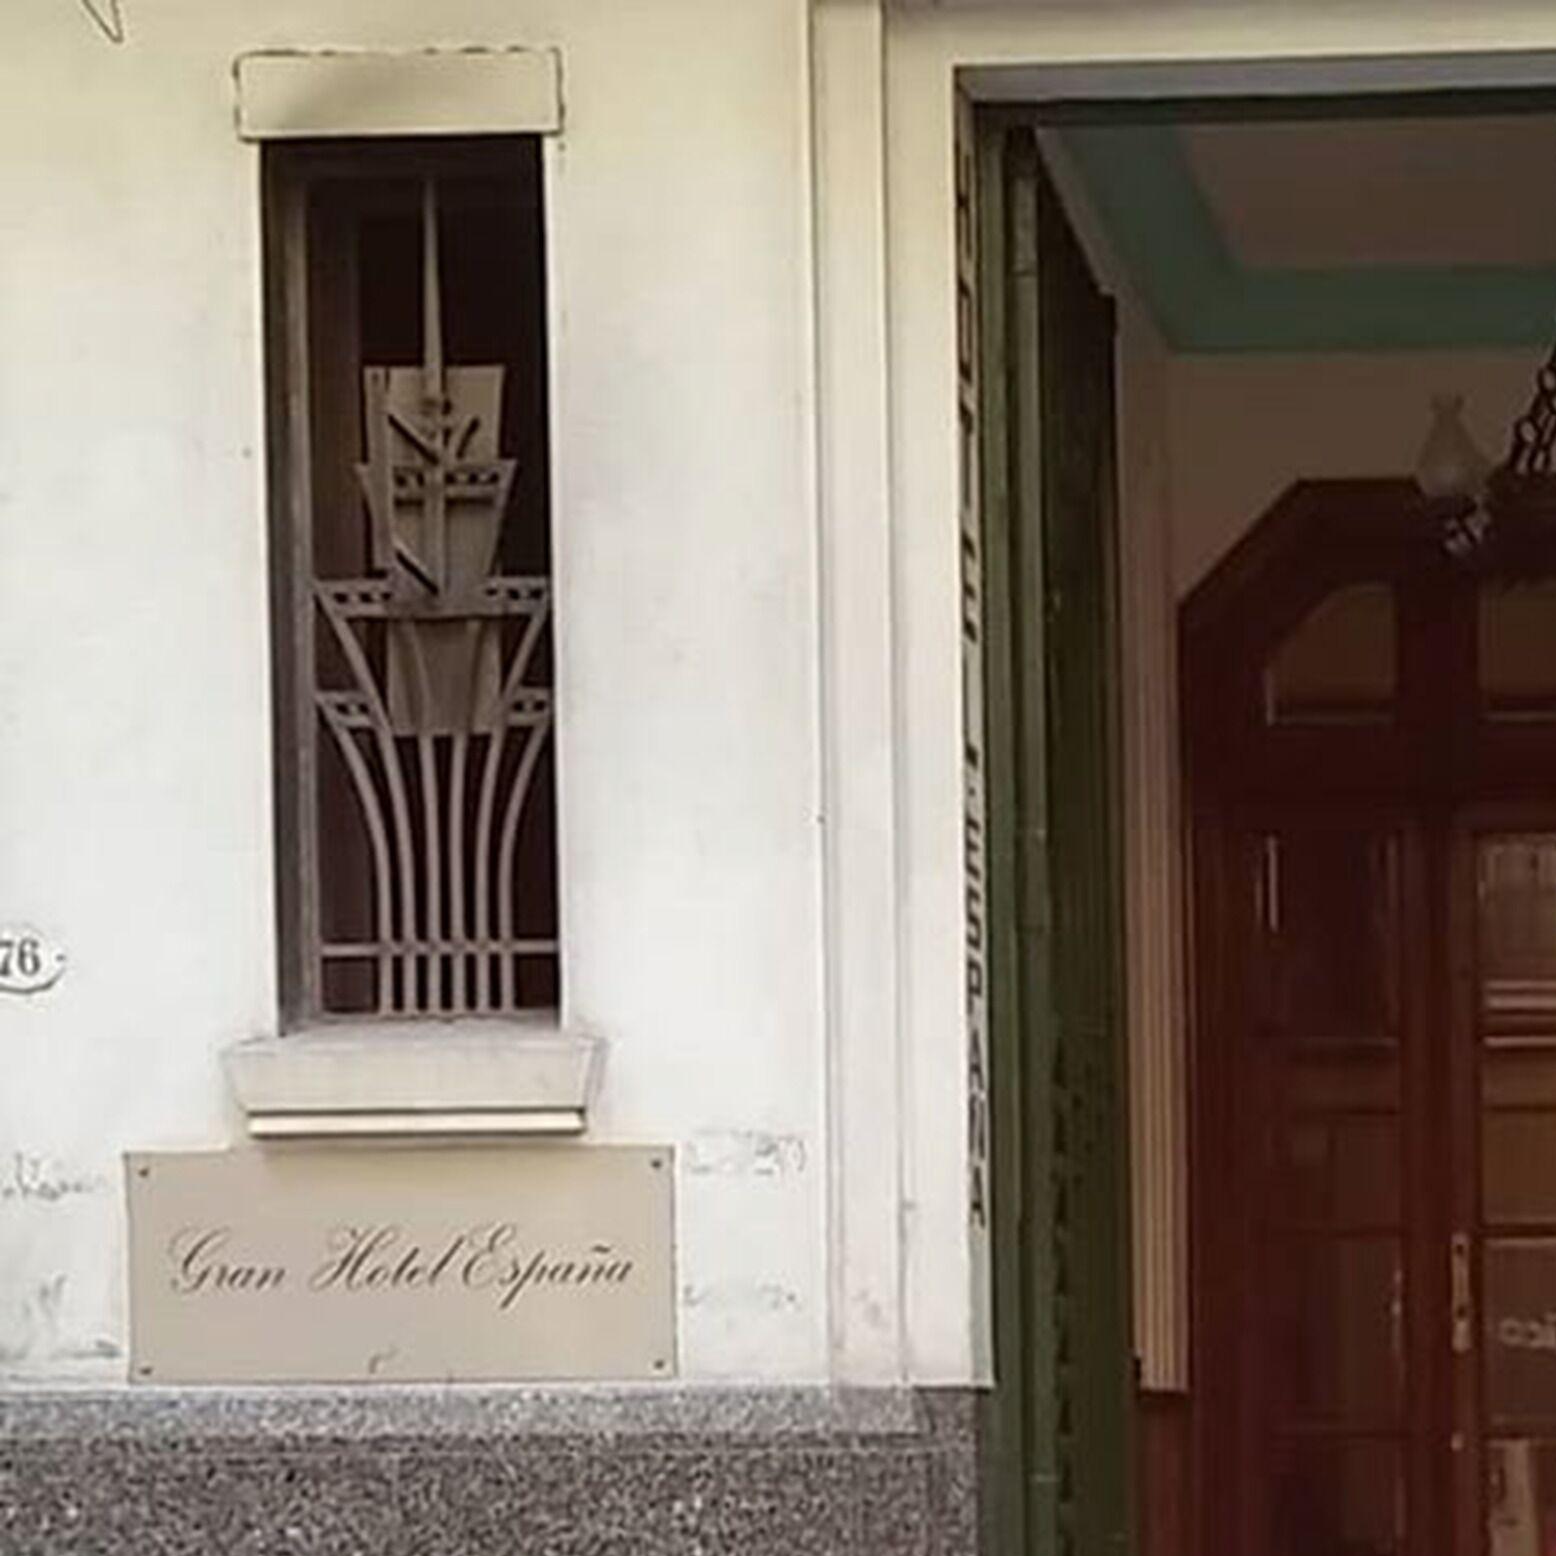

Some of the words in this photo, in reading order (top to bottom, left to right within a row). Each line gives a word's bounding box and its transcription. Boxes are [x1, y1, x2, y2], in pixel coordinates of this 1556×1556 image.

[0, 938, 41, 978] 76
[167, 1225, 287, 1297] Gran
[305, 1223, 456, 1294] Hotel
[458, 1224, 638, 1310] España
